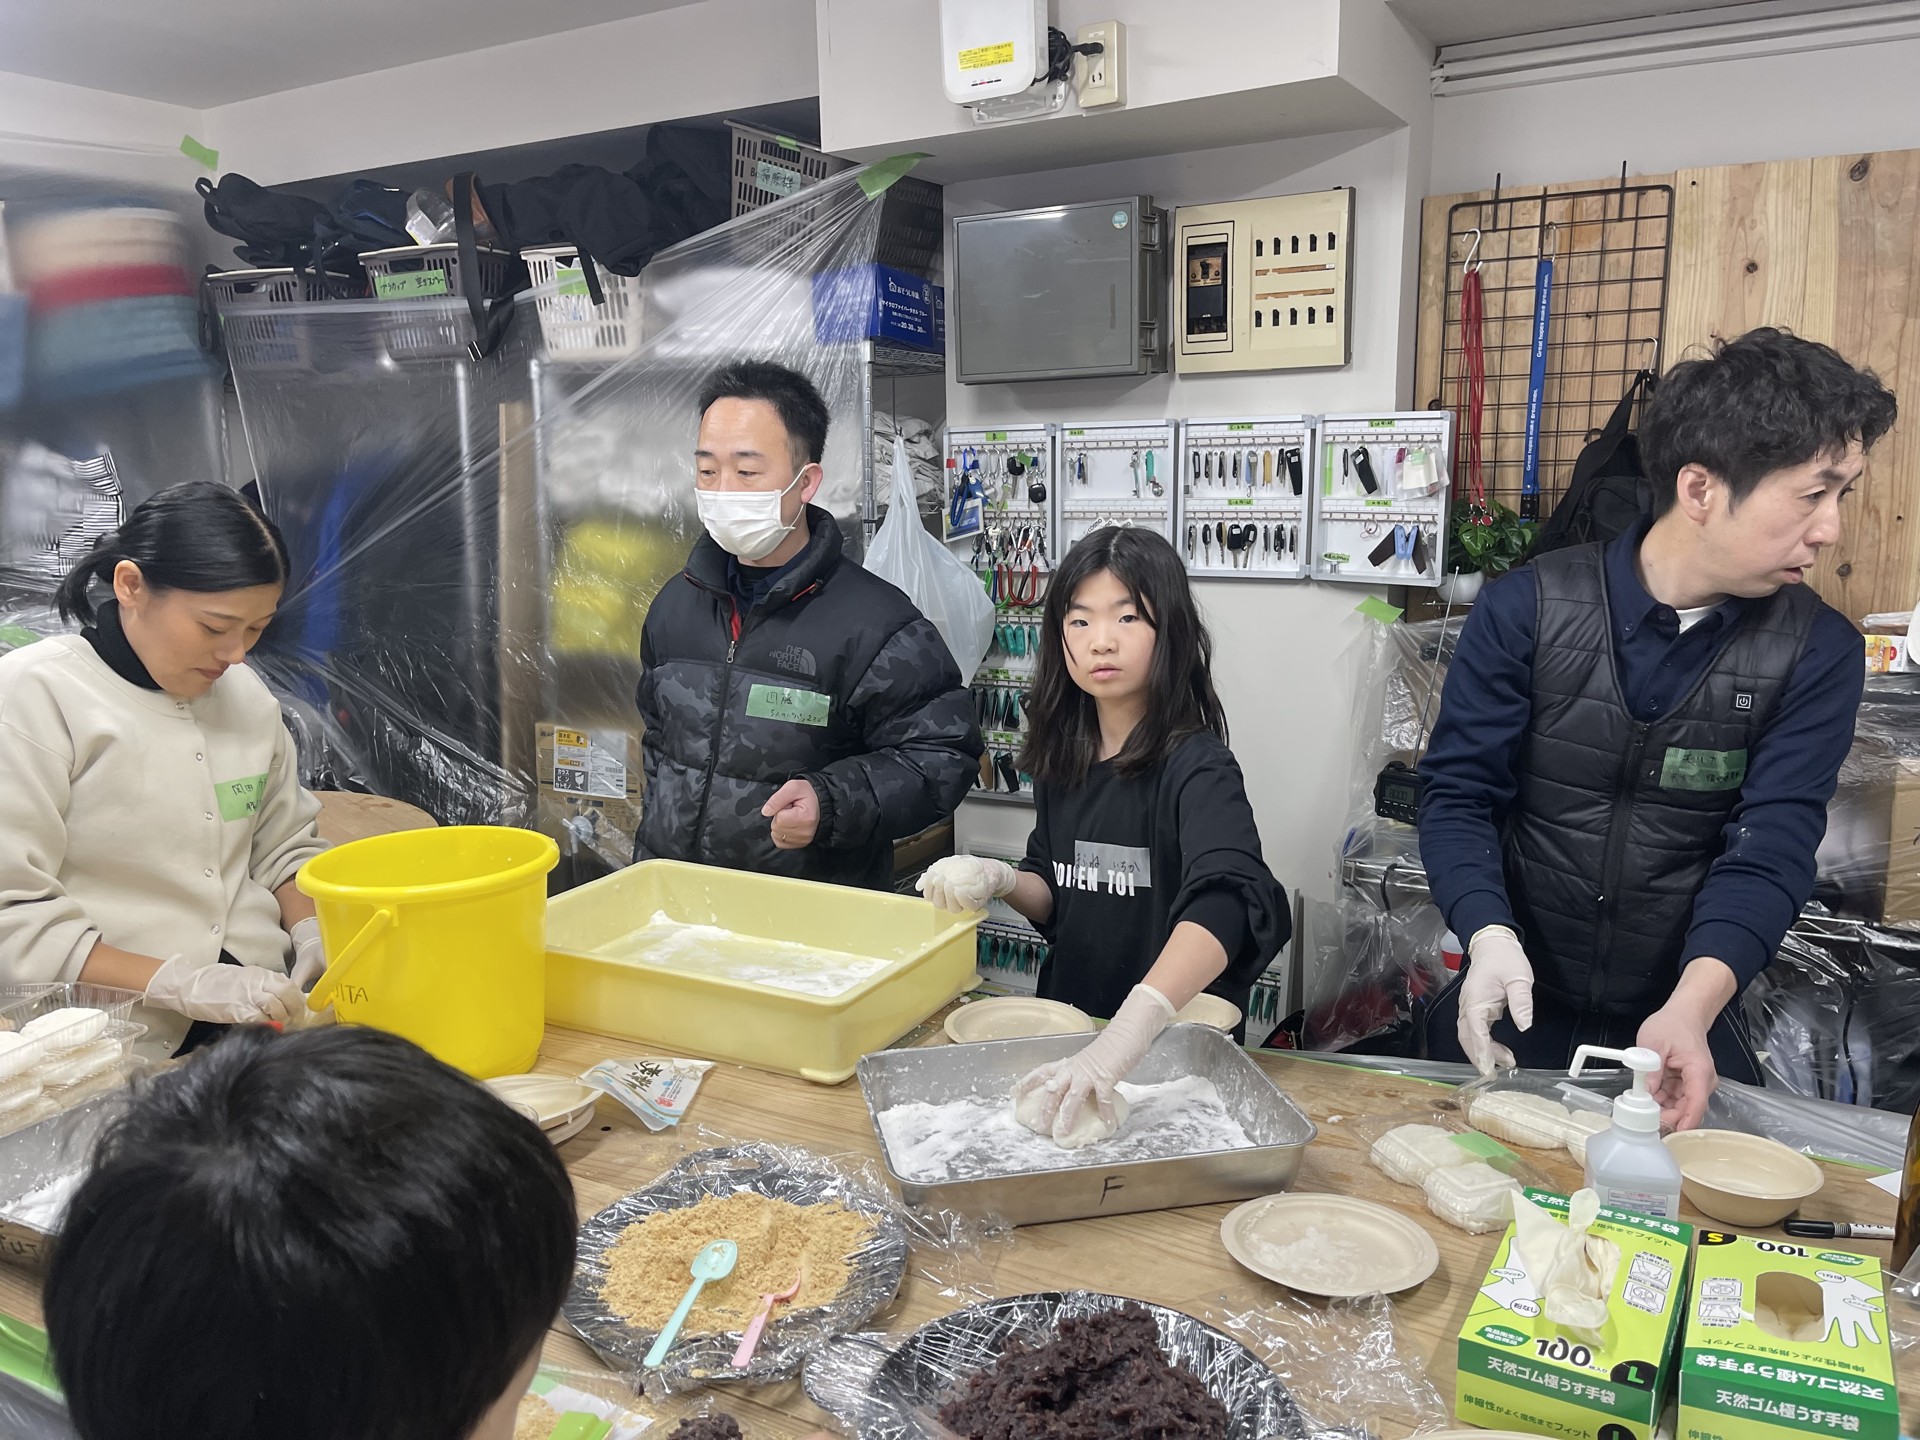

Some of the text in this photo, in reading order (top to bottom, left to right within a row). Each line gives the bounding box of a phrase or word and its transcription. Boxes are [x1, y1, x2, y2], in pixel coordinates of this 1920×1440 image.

[768, 650, 801, 665] NORTH
[786, 644, 802, 656] THE
[777, 659, 799, 673] FACE
[1107, 869, 1135, 897] TOI
[1100, 1175, 1126, 1206] F
[1707, 1232, 1724, 1243] S
[1756, 1240, 1810, 1258] 100
[1513, 1302, 1538, 1314] 粉なし
[1535, 1337, 1593, 1368] 100
[1486, 1355, 1617, 1406] 天然ゴム極うす手袋
[1627, 1365, 1645, 1384] L
[1695, 1353, 1886, 1401] 天然ゴム極うす手袋
[1462, 1392, 1592, 1439] 伸縮性がよく指先までフィット
[1715, 1388, 1861, 1432] 天然ゴム極うす手袋
